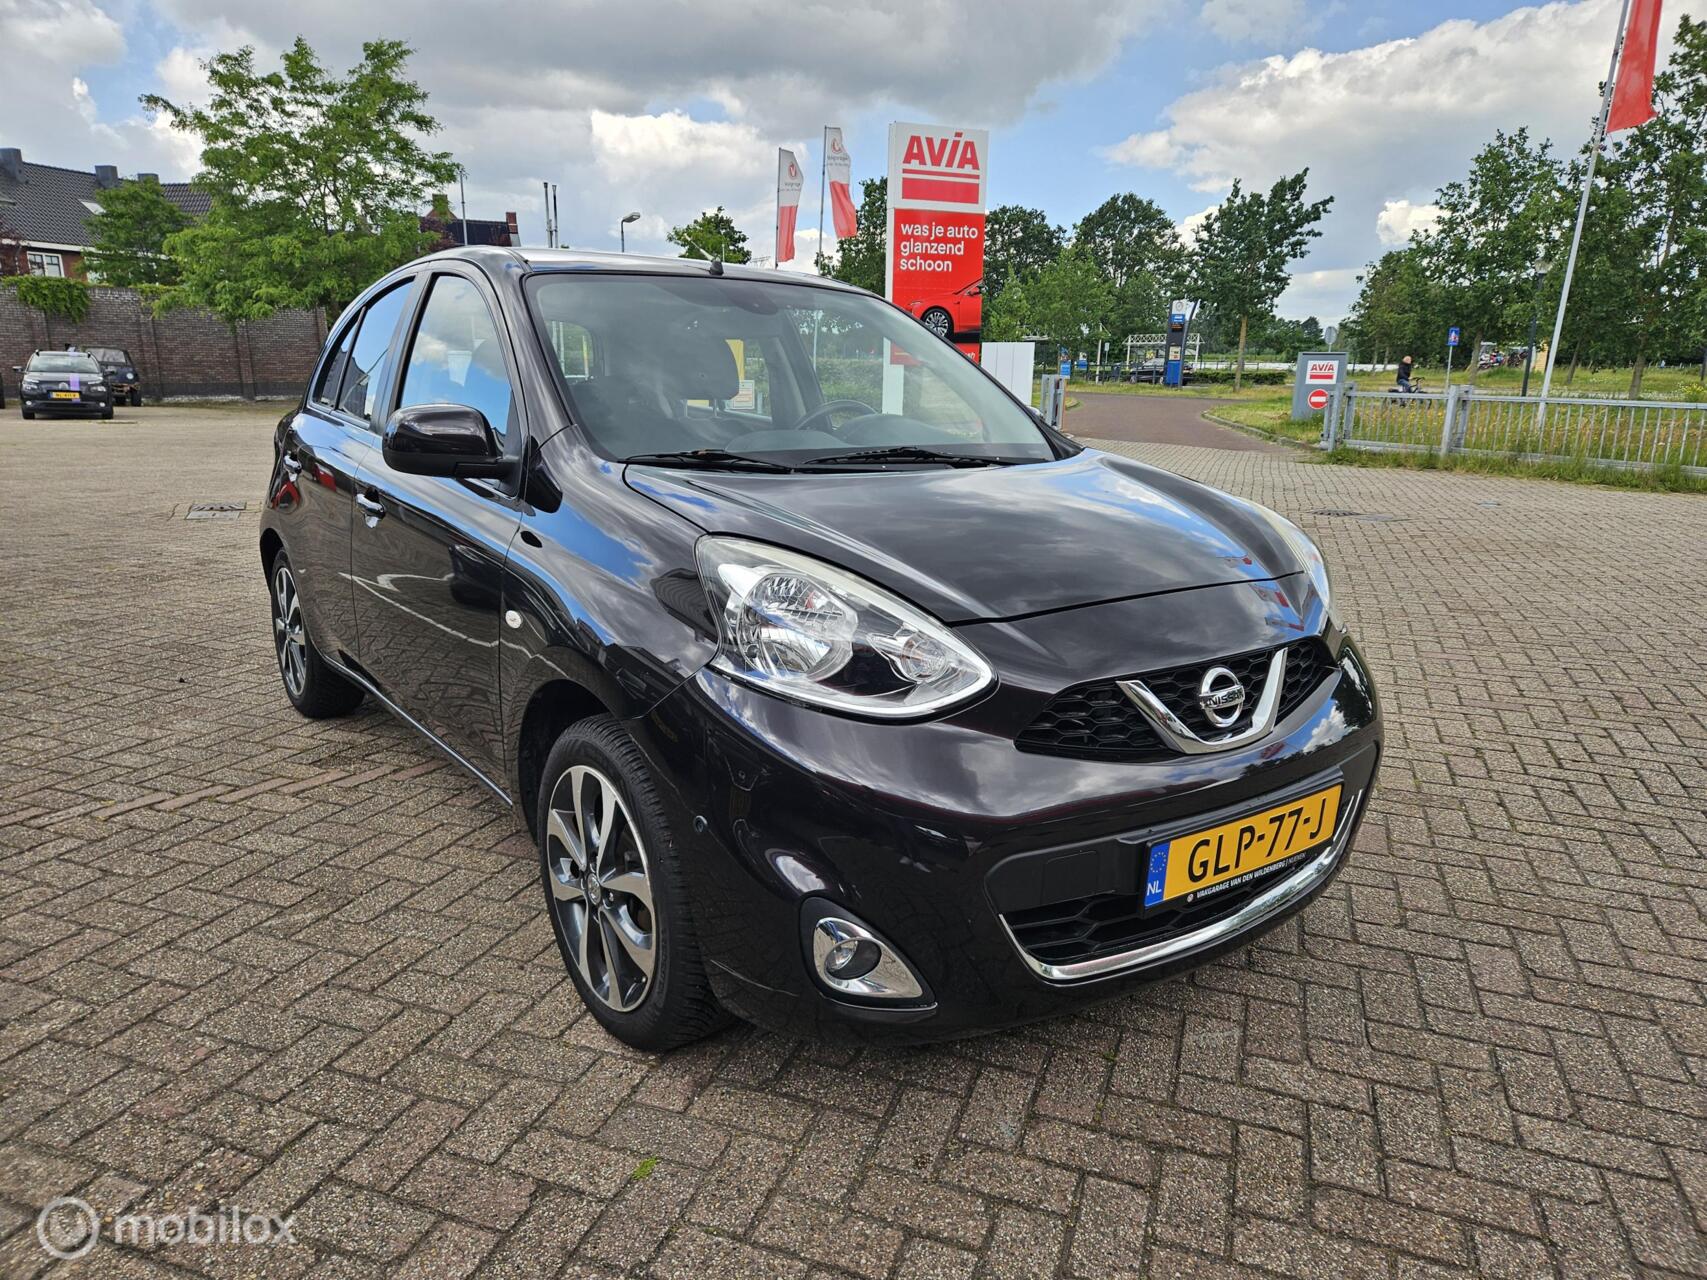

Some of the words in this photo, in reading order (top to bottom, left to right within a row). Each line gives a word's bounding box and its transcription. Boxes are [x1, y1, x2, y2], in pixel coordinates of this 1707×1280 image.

[901, 223, 929, 236] was
[930, 222, 944, 240] je
[947, 226, 979, 239] auto
[900, 238, 965, 256] glanzend
[899, 256, 952, 272] schoon
[1209, 689, 1244, 705] NISSAN
[1188, 798, 1327, 883] GLP-77-J
[1146, 880, 1162, 896] NL
[1196, 881, 1230, 898] VAKGARAGE
[1230, 876, 1242, 887] VAN
[1242, 872, 1254, 882] DEN
